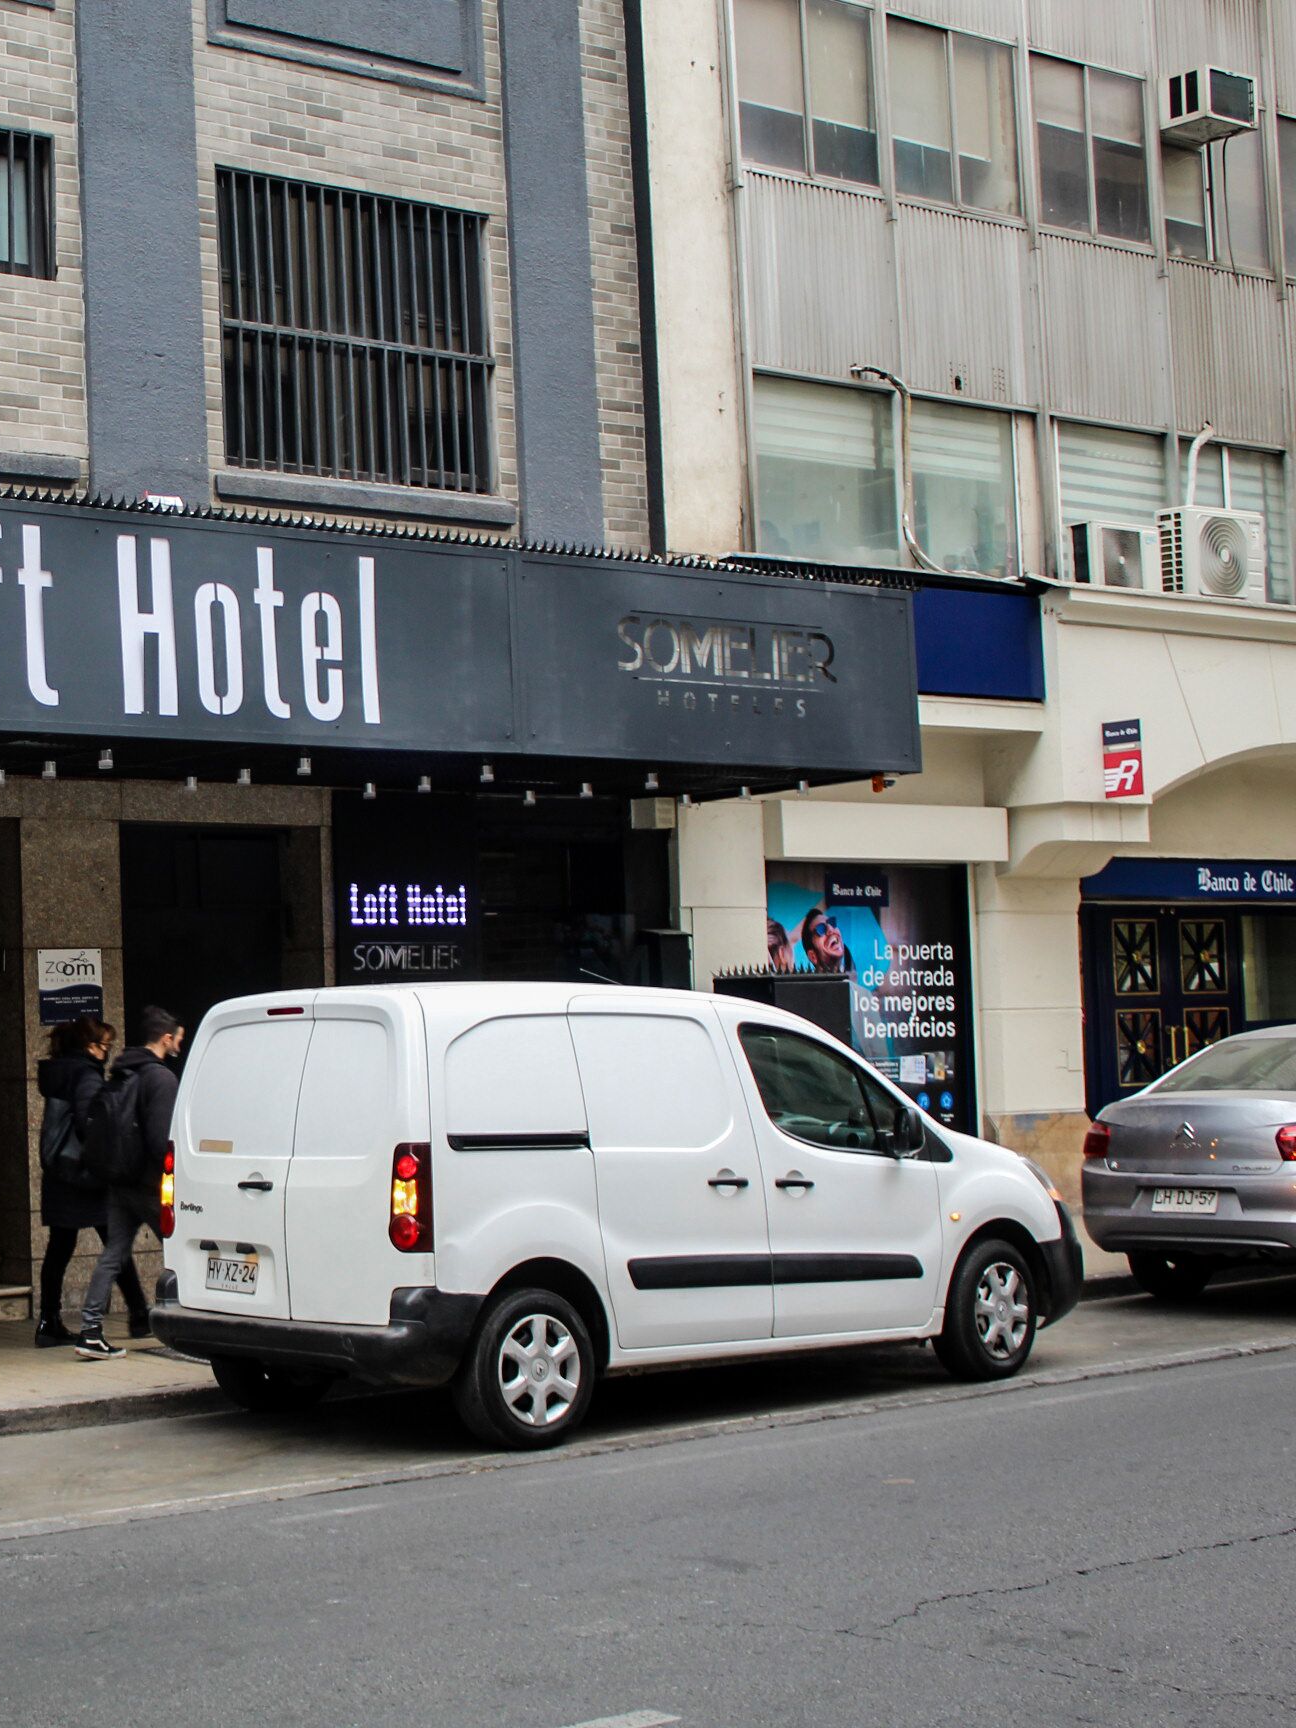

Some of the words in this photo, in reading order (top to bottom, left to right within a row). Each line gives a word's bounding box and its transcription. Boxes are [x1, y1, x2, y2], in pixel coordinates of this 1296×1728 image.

[116, 533, 381, 724] Hotel
[617, 615, 838, 684] SOMELIER
[656, 689, 807, 718] HOTELES
[832, 884, 855, 897] Banco
[856, 886, 863, 897] de
[864, 885, 882, 897] Chile
[1197, 867, 1240, 892] Banco
[1243, 871, 1257, 892] de
[1261, 869, 1294, 894] Chile
[350, 883, 398, 926] Loft
[406, 884, 467, 926] Hotel
[353, 944, 461, 971] SOMELIER
[874, 939, 896, 960] La
[898, 941, 954, 965] puerta
[862, 965, 884, 987] de
[889, 965, 954, 987] entrada
[854, 990, 880, 1012] los
[884, 990, 956, 1016] mejores
[863, 1016, 957, 1039] beneficios
